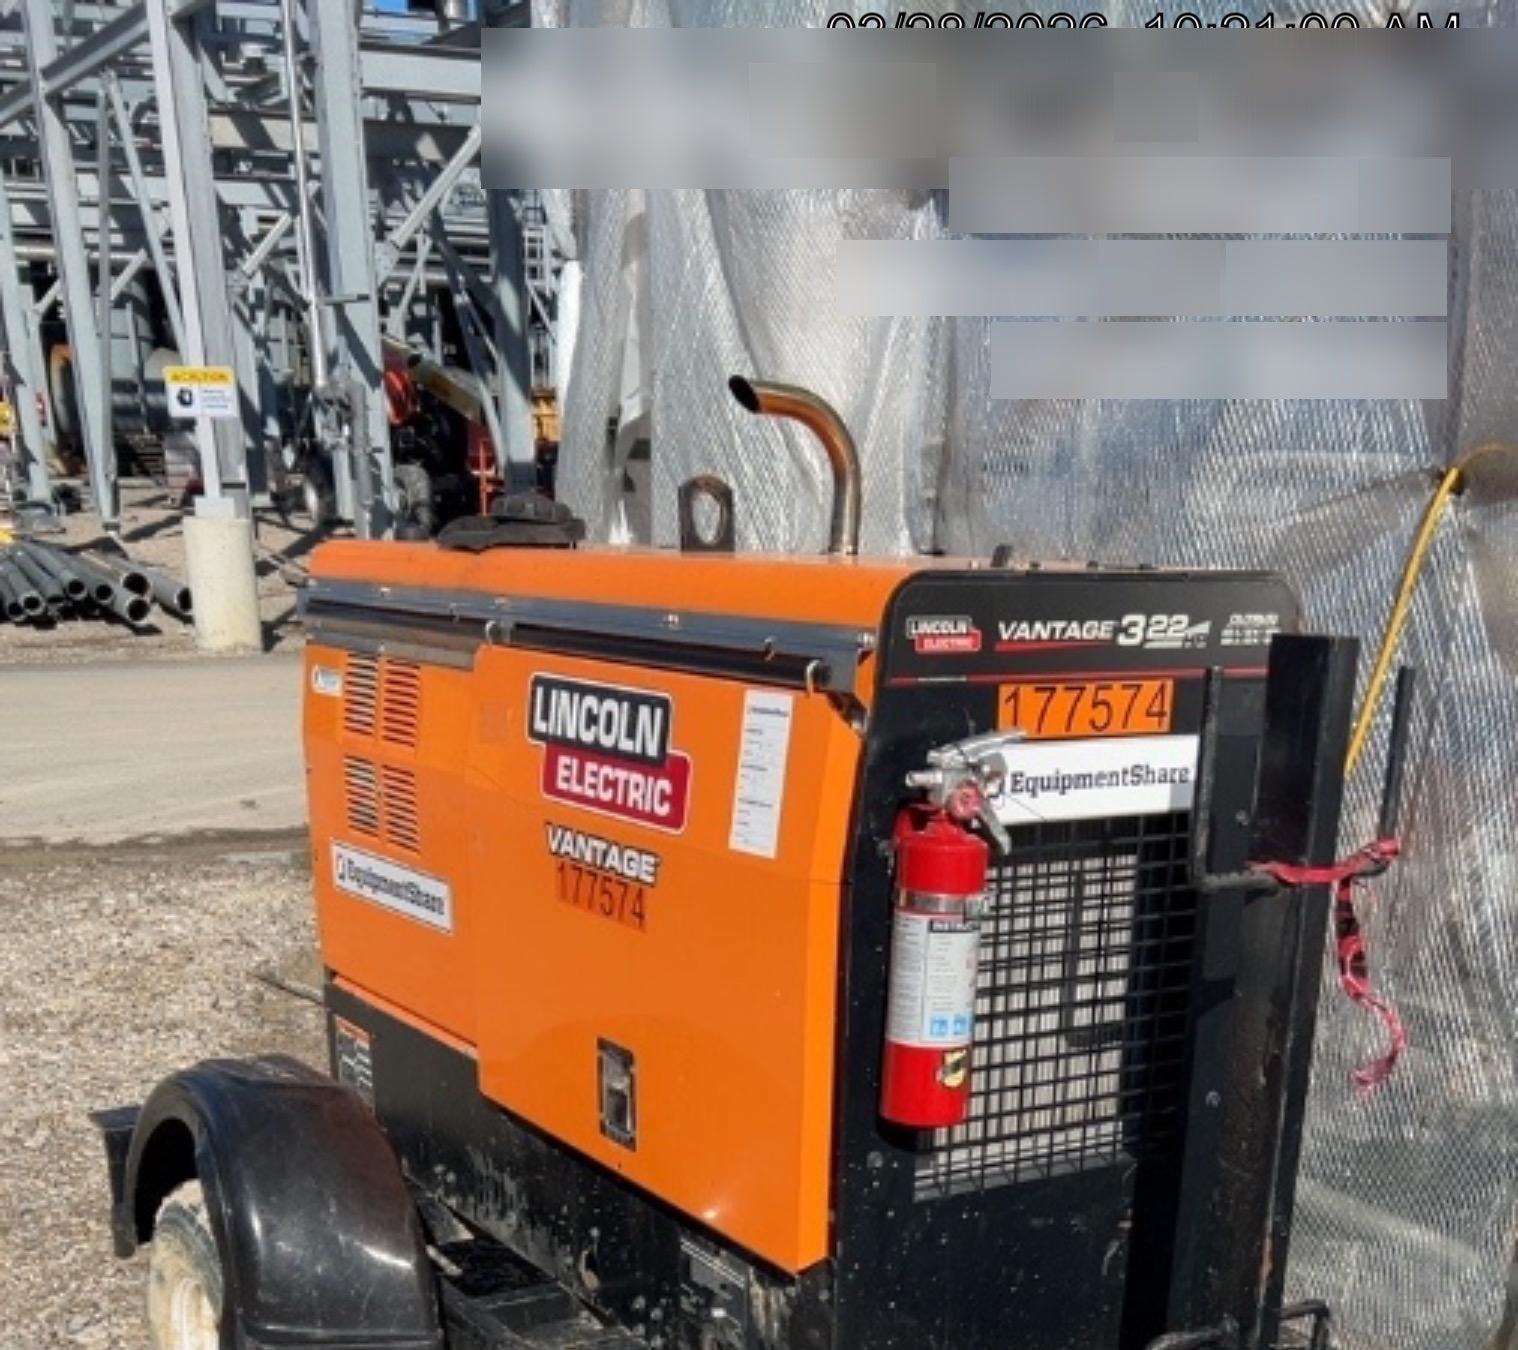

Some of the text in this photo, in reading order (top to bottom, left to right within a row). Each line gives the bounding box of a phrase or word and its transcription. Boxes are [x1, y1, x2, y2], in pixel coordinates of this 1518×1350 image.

[911, 620, 969, 635] LINCOLN
[998, 620, 1117, 641] VANTAGE
[1117, 614, 1190, 646] 322
[532, 685, 664, 758] LINCOLN
[1003, 681, 1168, 734] 177574
[556, 754, 673, 817] ELECTRIC
[1009, 763, 1190, 798] EquipmentShare
[545, 821, 661, 886] VANTAGE
[557, 860, 646, 929] 177574
